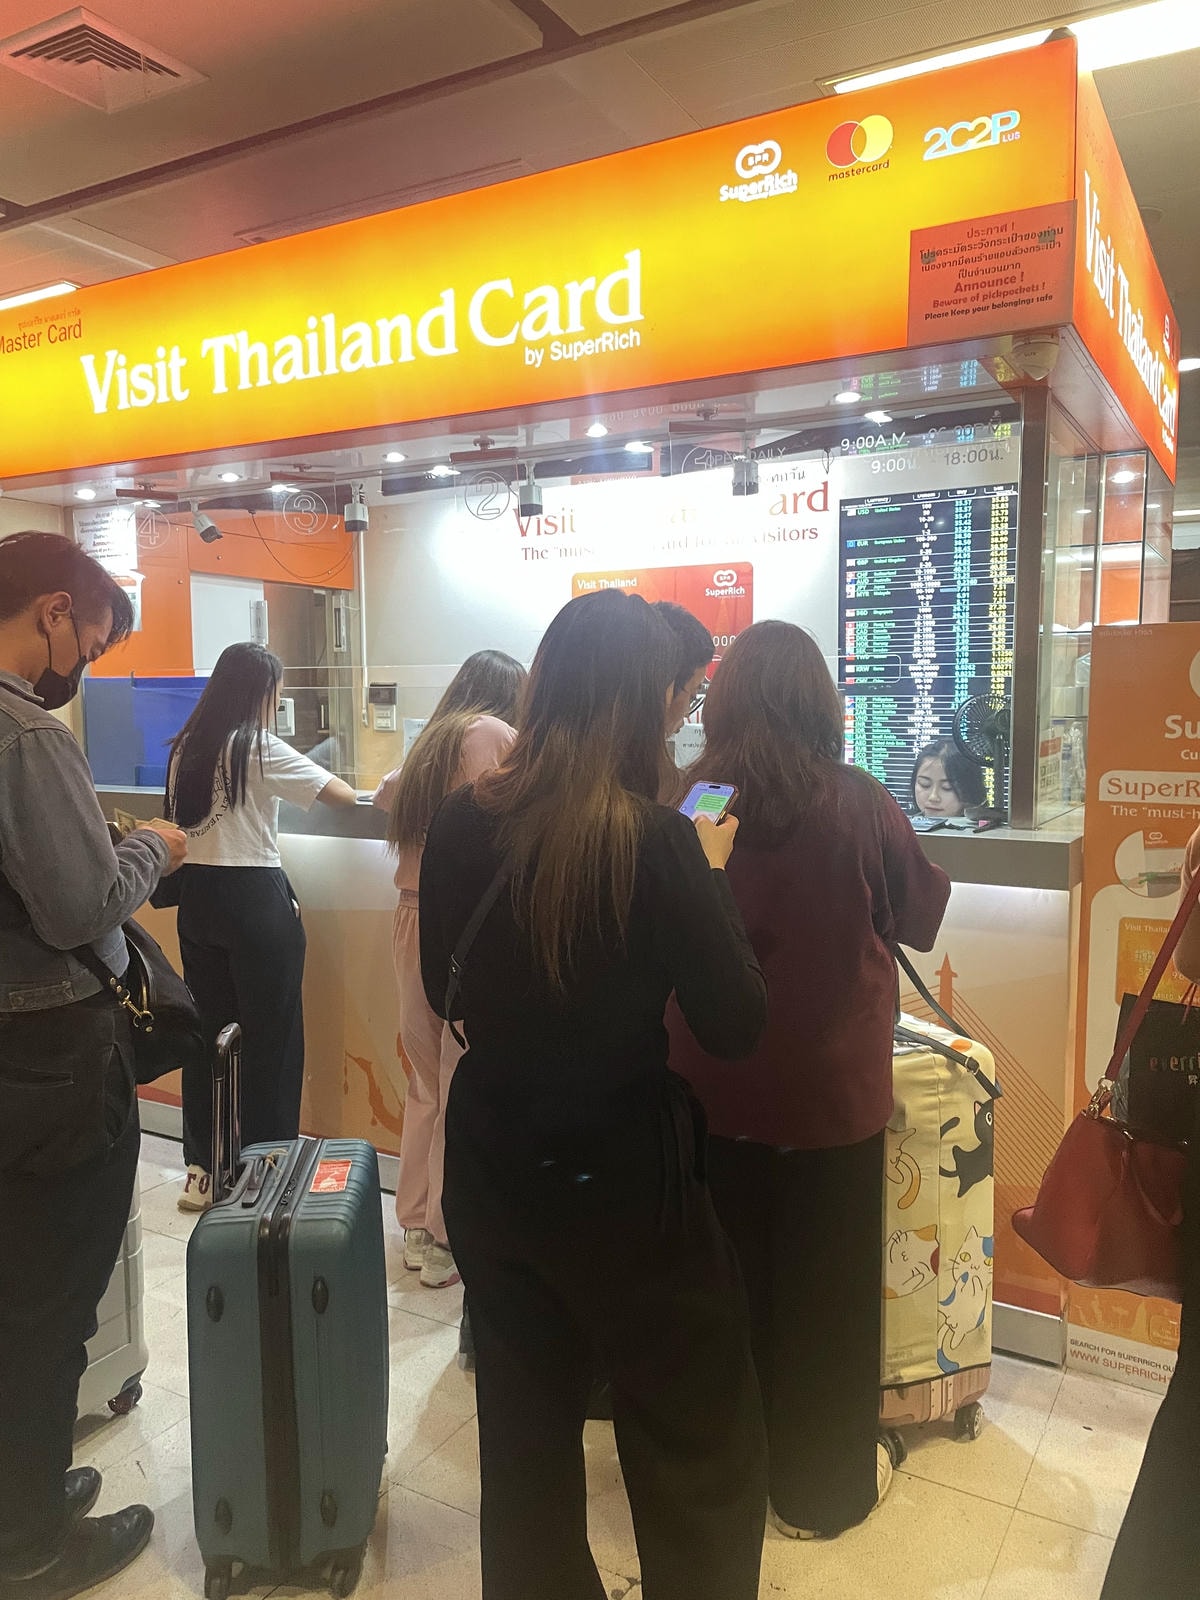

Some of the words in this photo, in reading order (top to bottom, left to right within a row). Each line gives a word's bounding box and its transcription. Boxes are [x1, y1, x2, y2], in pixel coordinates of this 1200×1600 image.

[923, 110, 1021, 161] 2C2P
[719, 168, 798, 203] SuperRich
[828, 159, 891, 182] mastercard
[932, 293, 968, 309] Beware
[970, 292, 980, 303] of
[982, 284, 1040, 302] pickpockets
[954, 275, 1017, 294] Announce
[1083, 170, 1116, 319] Visit
[1117, 262, 1159, 406] Thailand
[924, 308, 949, 321] Please
[950, 307, 971, 318] Keep
[972, 303, 990, 315] your
[991, 297, 1034, 310] belongings
[1036, 293, 1053, 303] safe
[47, 318, 82, 344] Card
[80, 349, 190, 414] Visit
[201, 287, 459, 395] Thailand
[468, 248, 645, 348] Card
[524, 345, 545, 369] by
[549, 327, 641, 362] SuperRich
[293, 495, 318, 527] 3
[477, 476, 501, 515] 2
[139, 511, 160, 545] 4
[577, 579, 599, 590] Visit
[600, 577, 637, 589] Thailand
[705, 586, 746, 598] SuperRich
[1111, 805, 1138, 817] The
[1070, 1338, 1100, 1354] SEARCH
[1101, 1346, 1116, 1358] FOR
[1117, 1350, 1161, 1369] SUPERRICH
